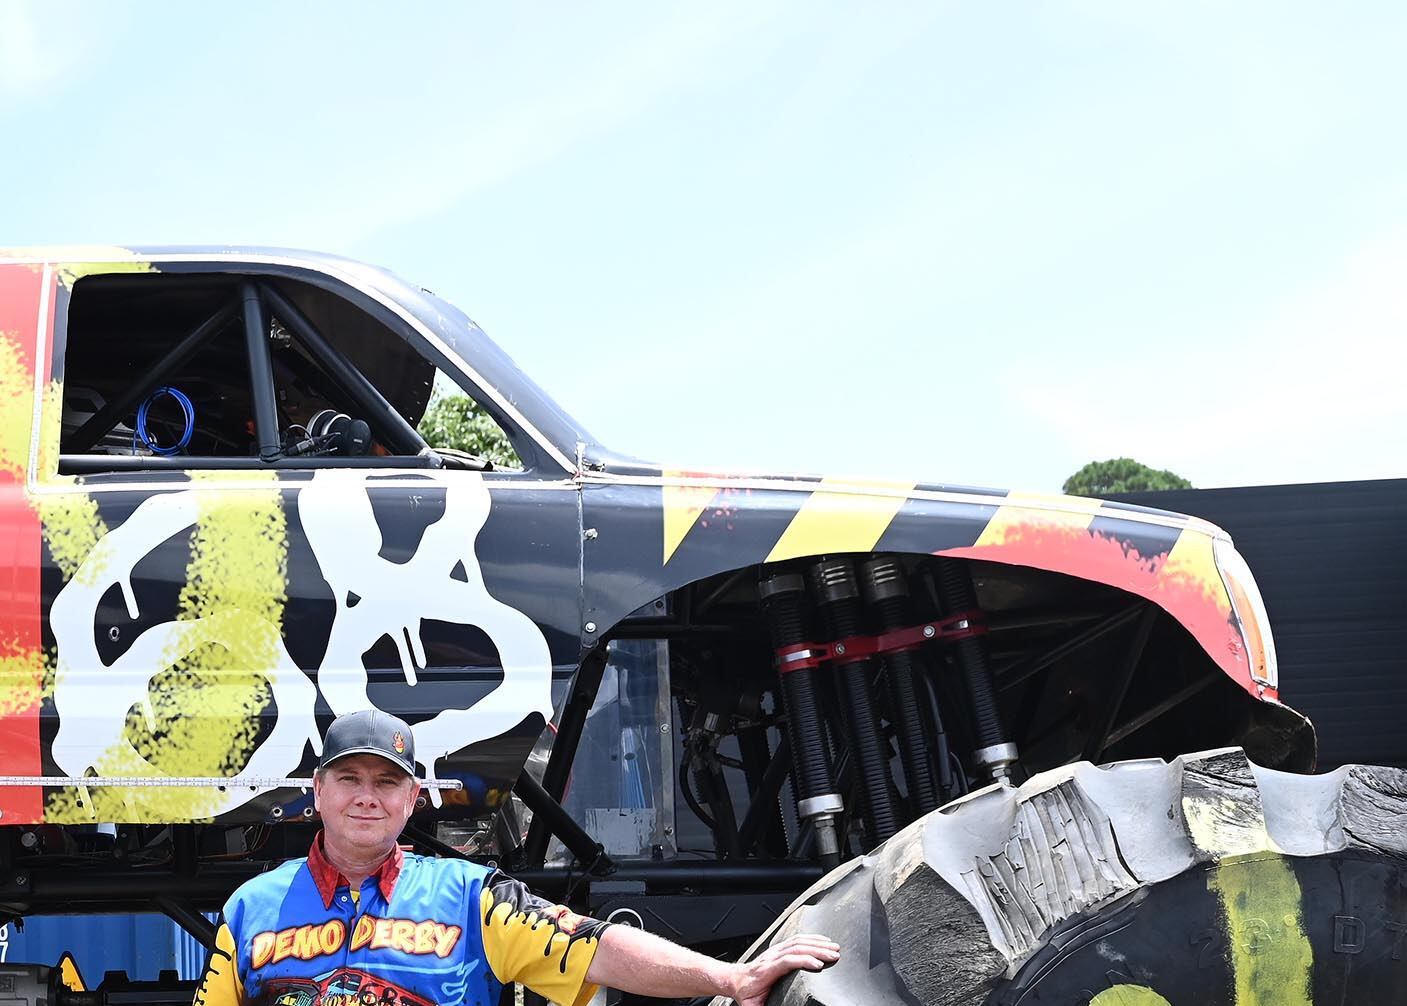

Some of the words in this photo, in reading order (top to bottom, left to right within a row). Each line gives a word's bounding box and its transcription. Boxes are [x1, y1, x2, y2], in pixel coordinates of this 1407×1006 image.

[50, 470, 554, 820] 68
[252, 918, 346, 970] DEMO
[350, 915, 462, 958] DERBY
